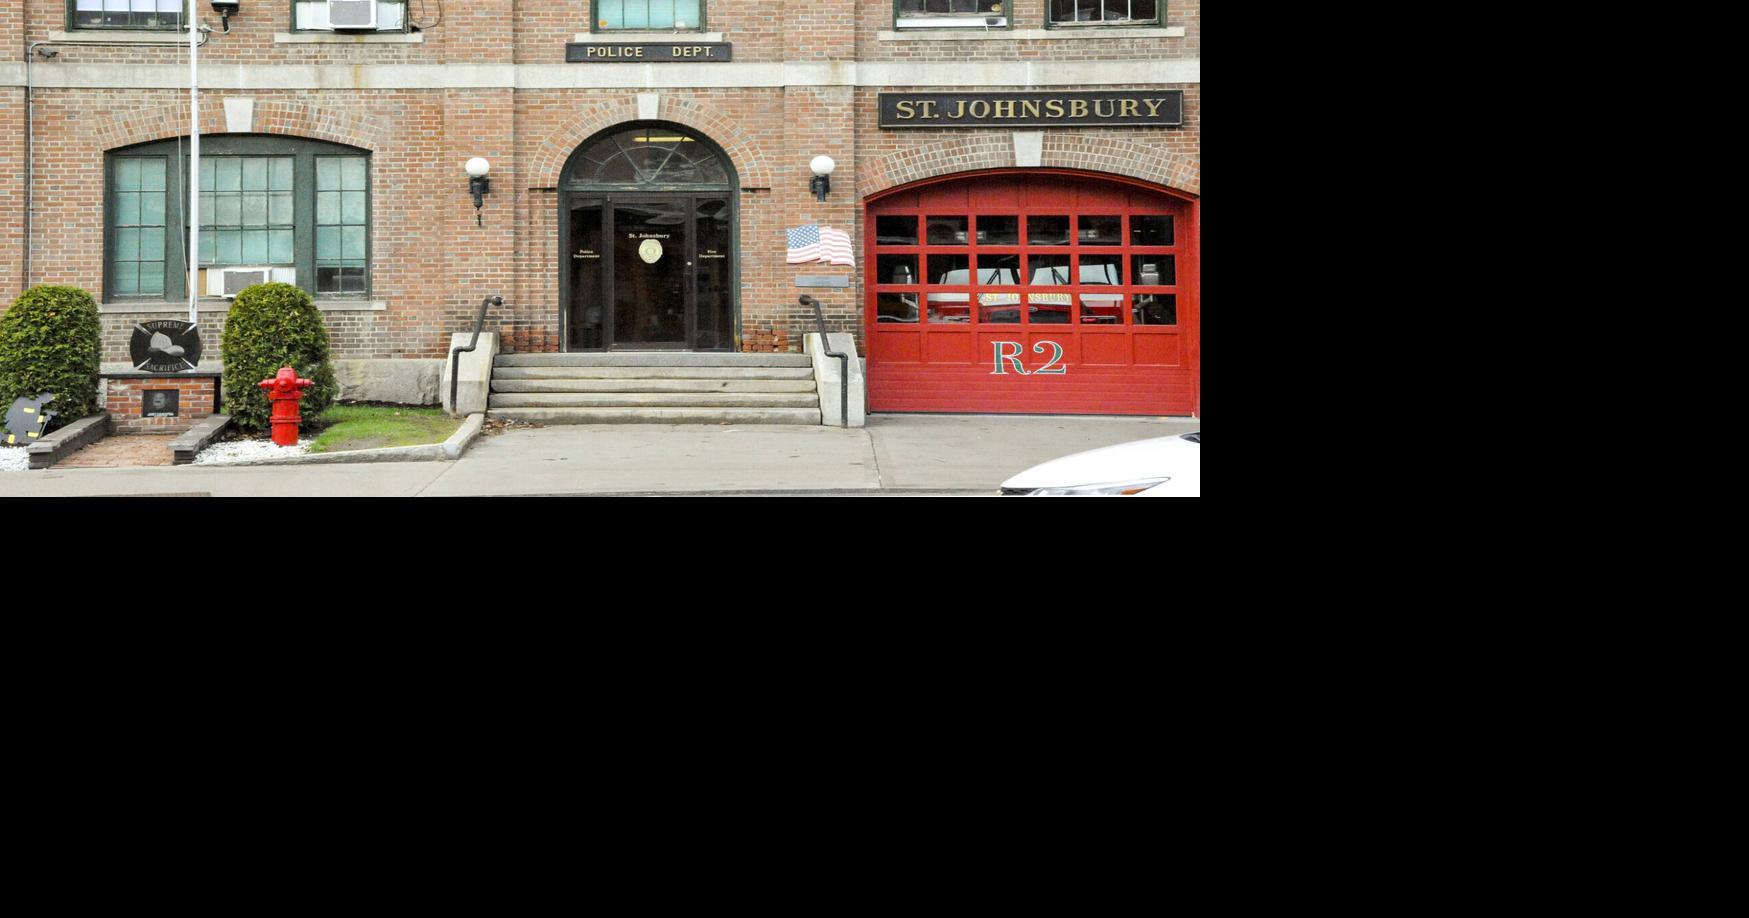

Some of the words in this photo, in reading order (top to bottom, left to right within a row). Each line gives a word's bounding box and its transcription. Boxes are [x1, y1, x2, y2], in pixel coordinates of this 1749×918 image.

[587, 46, 643, 57] POLICE
[672, 46, 714, 57] DEPT.
[896, 100, 940, 119] ST.
[947, 98, 1167, 119] JOHNSBURY
[146, 321, 185, 329] SUPREME
[989, 340, 1067, 376] R2
